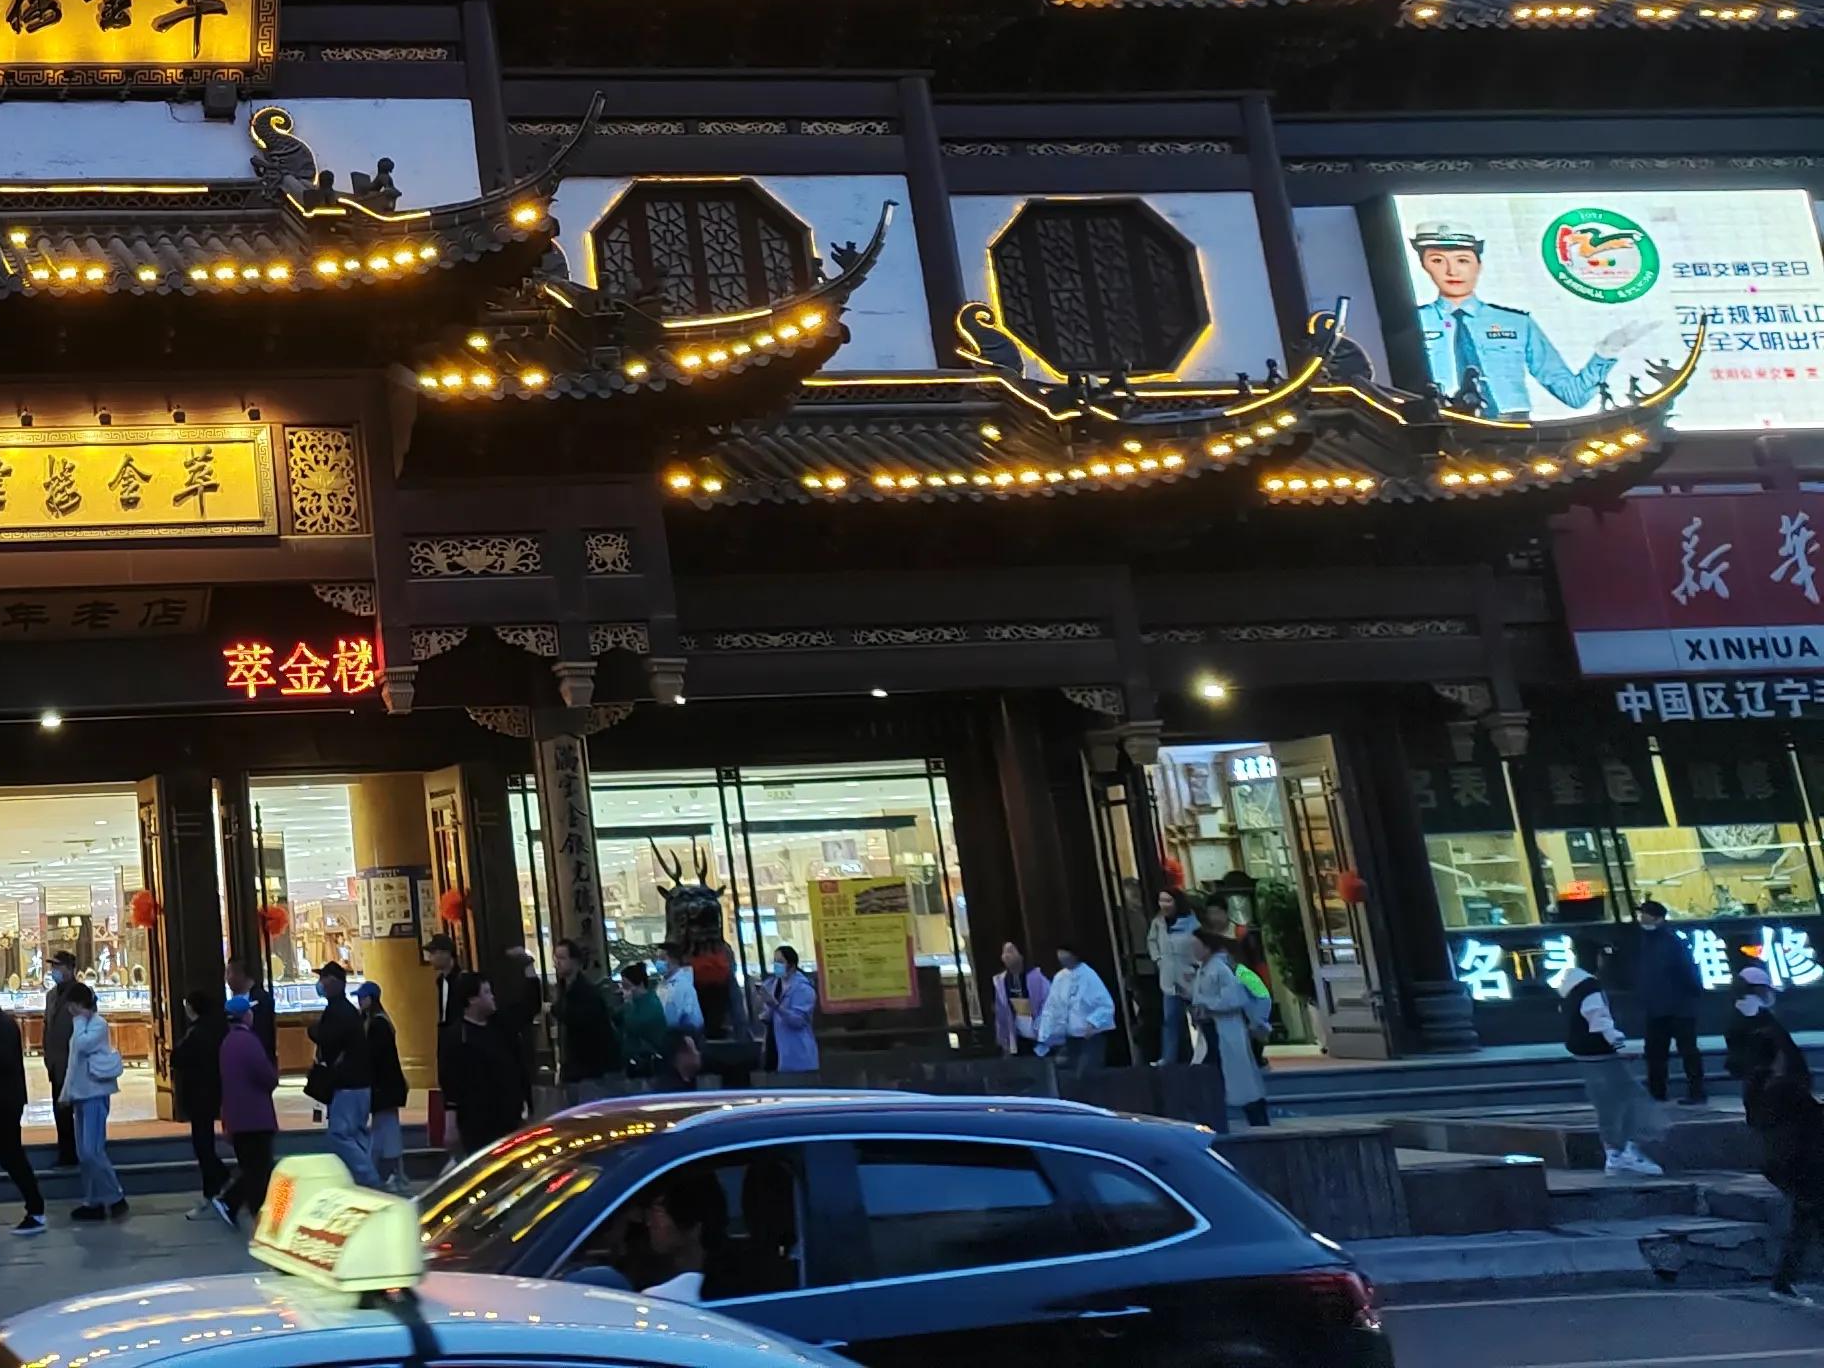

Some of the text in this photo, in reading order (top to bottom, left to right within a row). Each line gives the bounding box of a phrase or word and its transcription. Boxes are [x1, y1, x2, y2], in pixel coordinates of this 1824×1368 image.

[223, 638, 376, 699] 萃金楼
[1685, 635, 1821, 662] XINHUA
[1616, 678, 1824, 723] 中国区辽宁
